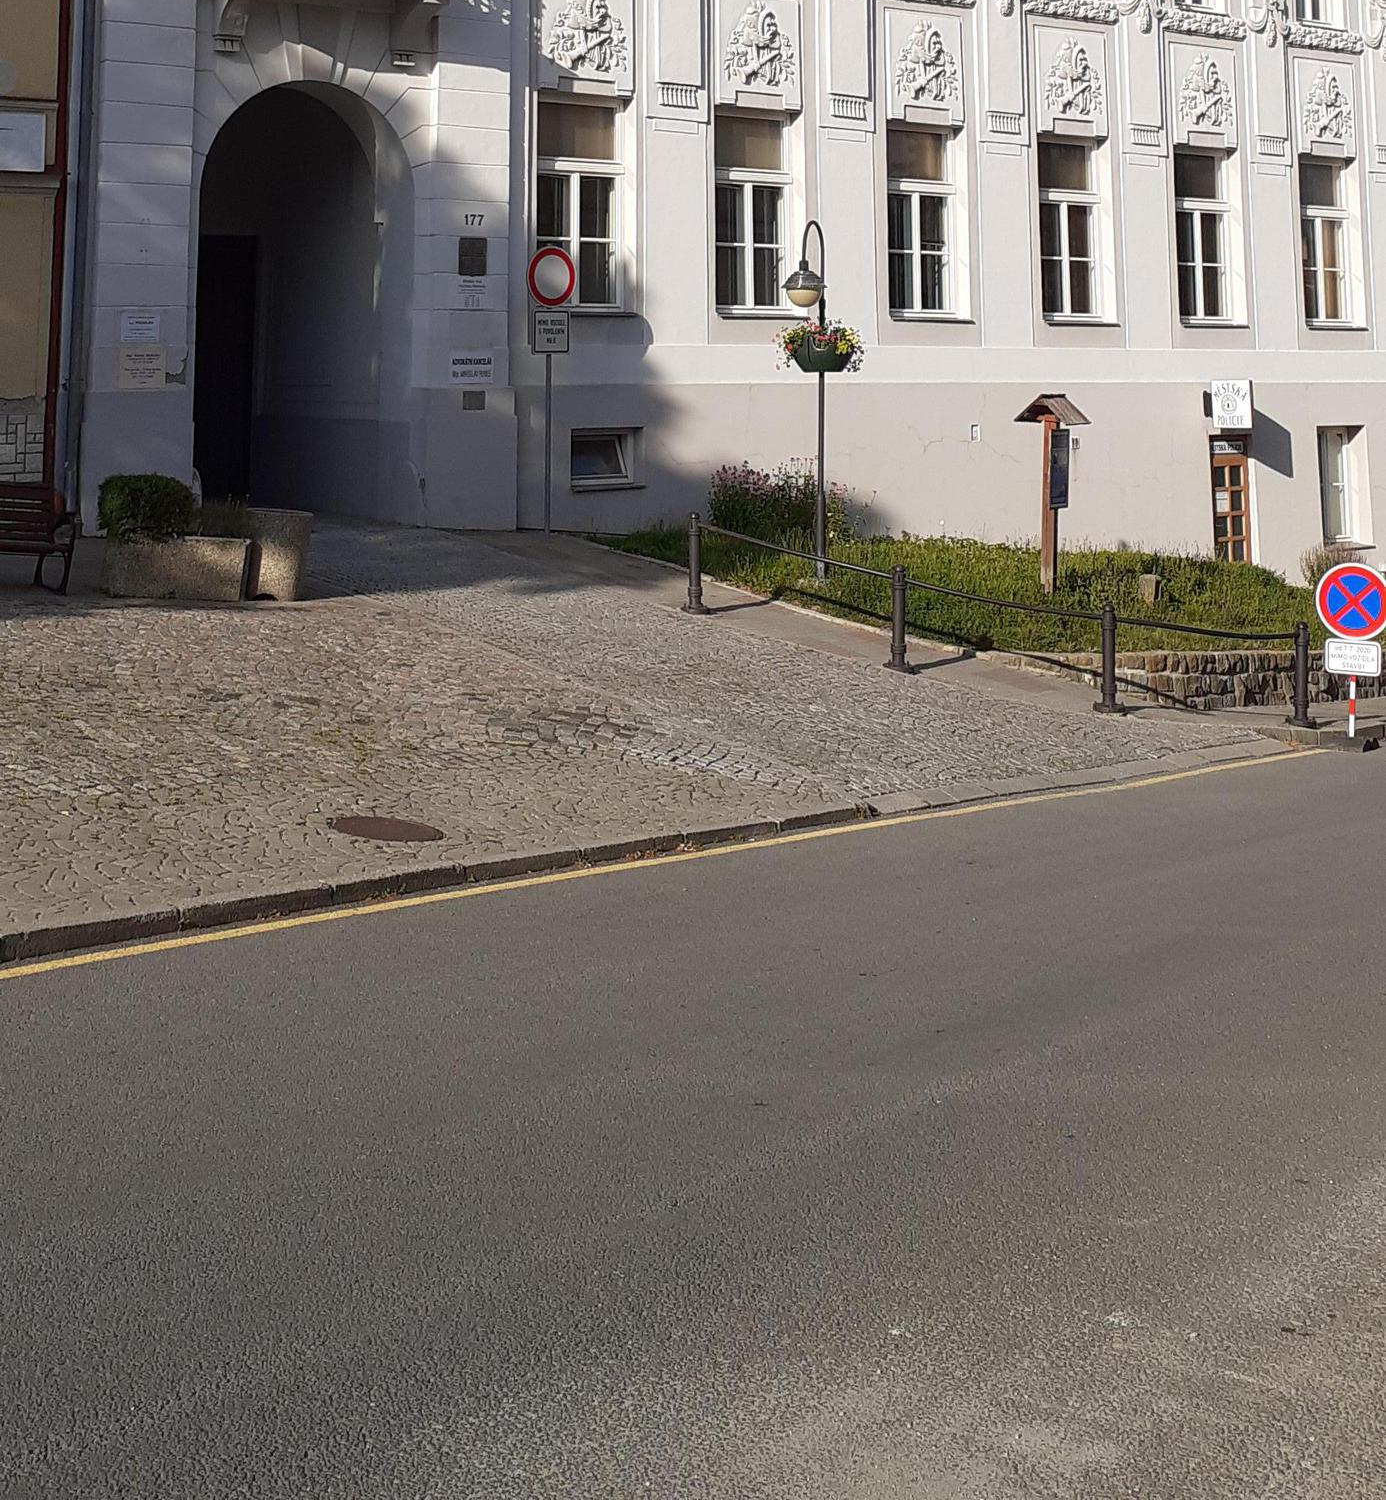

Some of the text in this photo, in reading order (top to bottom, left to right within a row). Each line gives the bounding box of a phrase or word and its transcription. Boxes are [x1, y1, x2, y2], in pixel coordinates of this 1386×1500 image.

[464, 214, 485, 226] 177
[1213, 383, 1248, 402] MĚSTSKÁ
[1217, 414, 1245, 427] POLICIE
